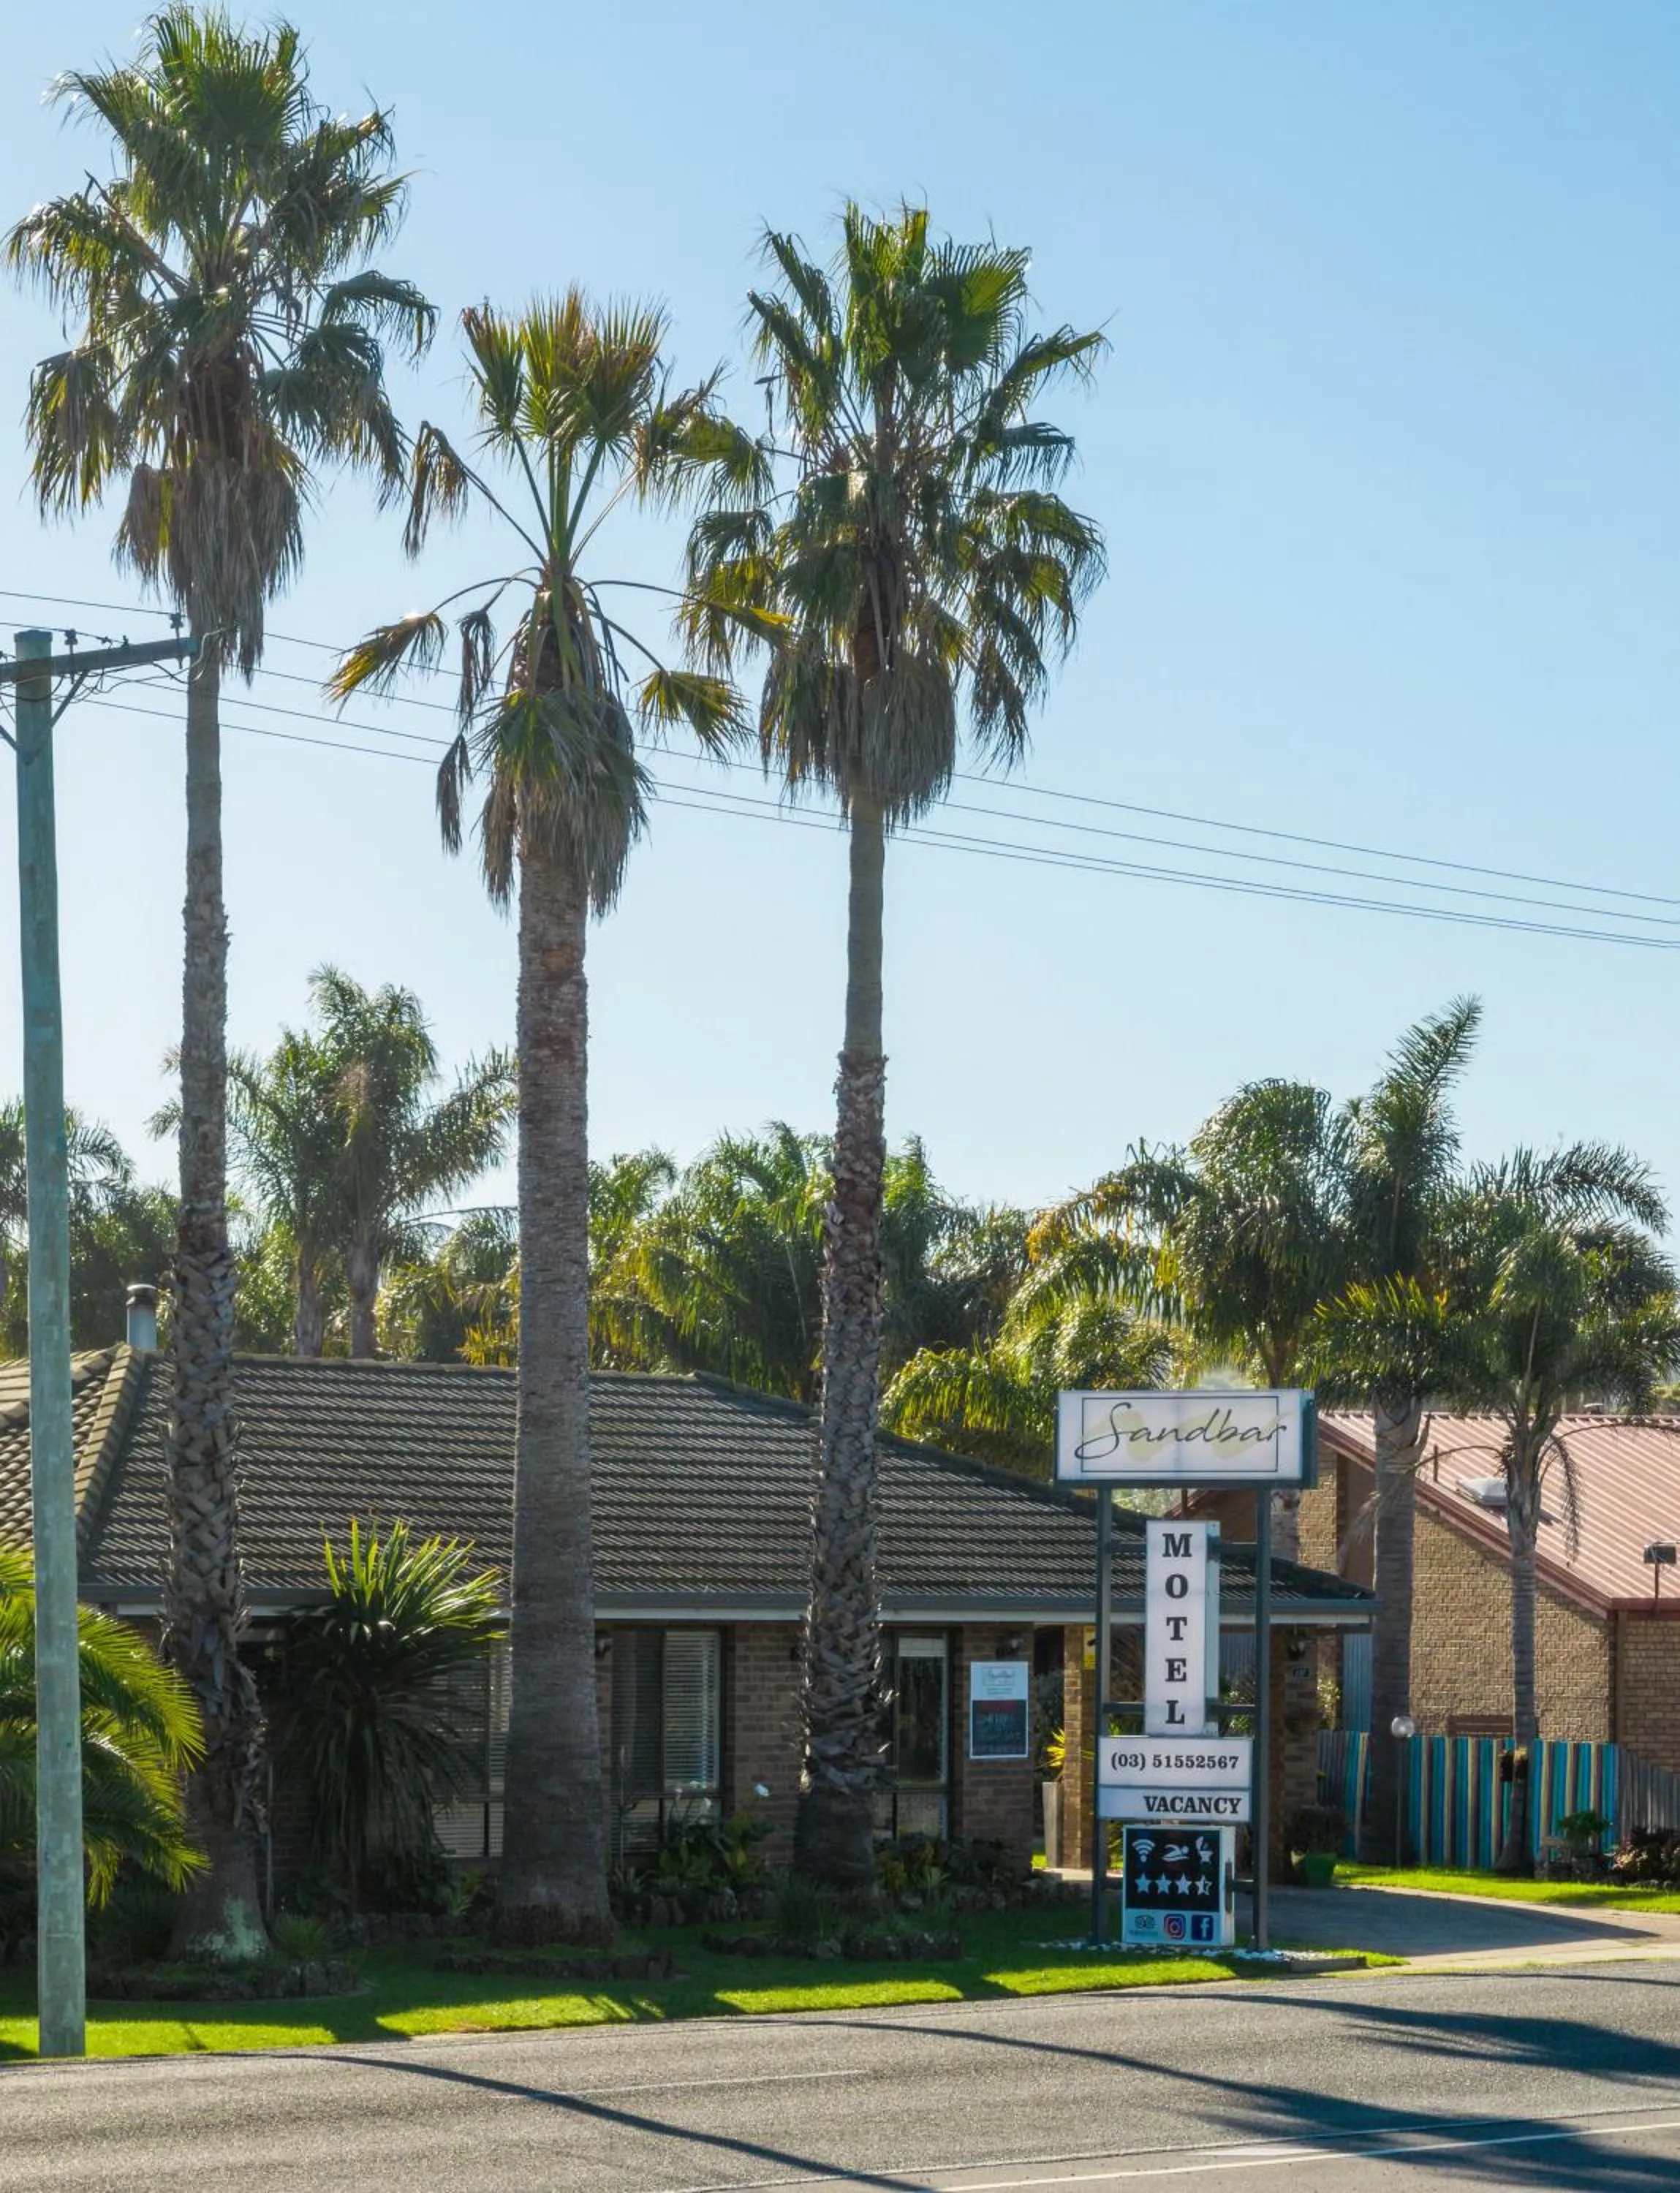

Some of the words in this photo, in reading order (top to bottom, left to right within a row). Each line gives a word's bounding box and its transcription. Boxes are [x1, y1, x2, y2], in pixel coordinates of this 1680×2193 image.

[1075, 1402, 1287, 1459] Sandbar
[1162, 1533, 1192, 1725] MOTEL
[1111, 1752, 1146, 1770] (03)
[1153, 1754, 1239, 1769] 51552567
[1143, 1795, 1242, 1814] VACANCY
